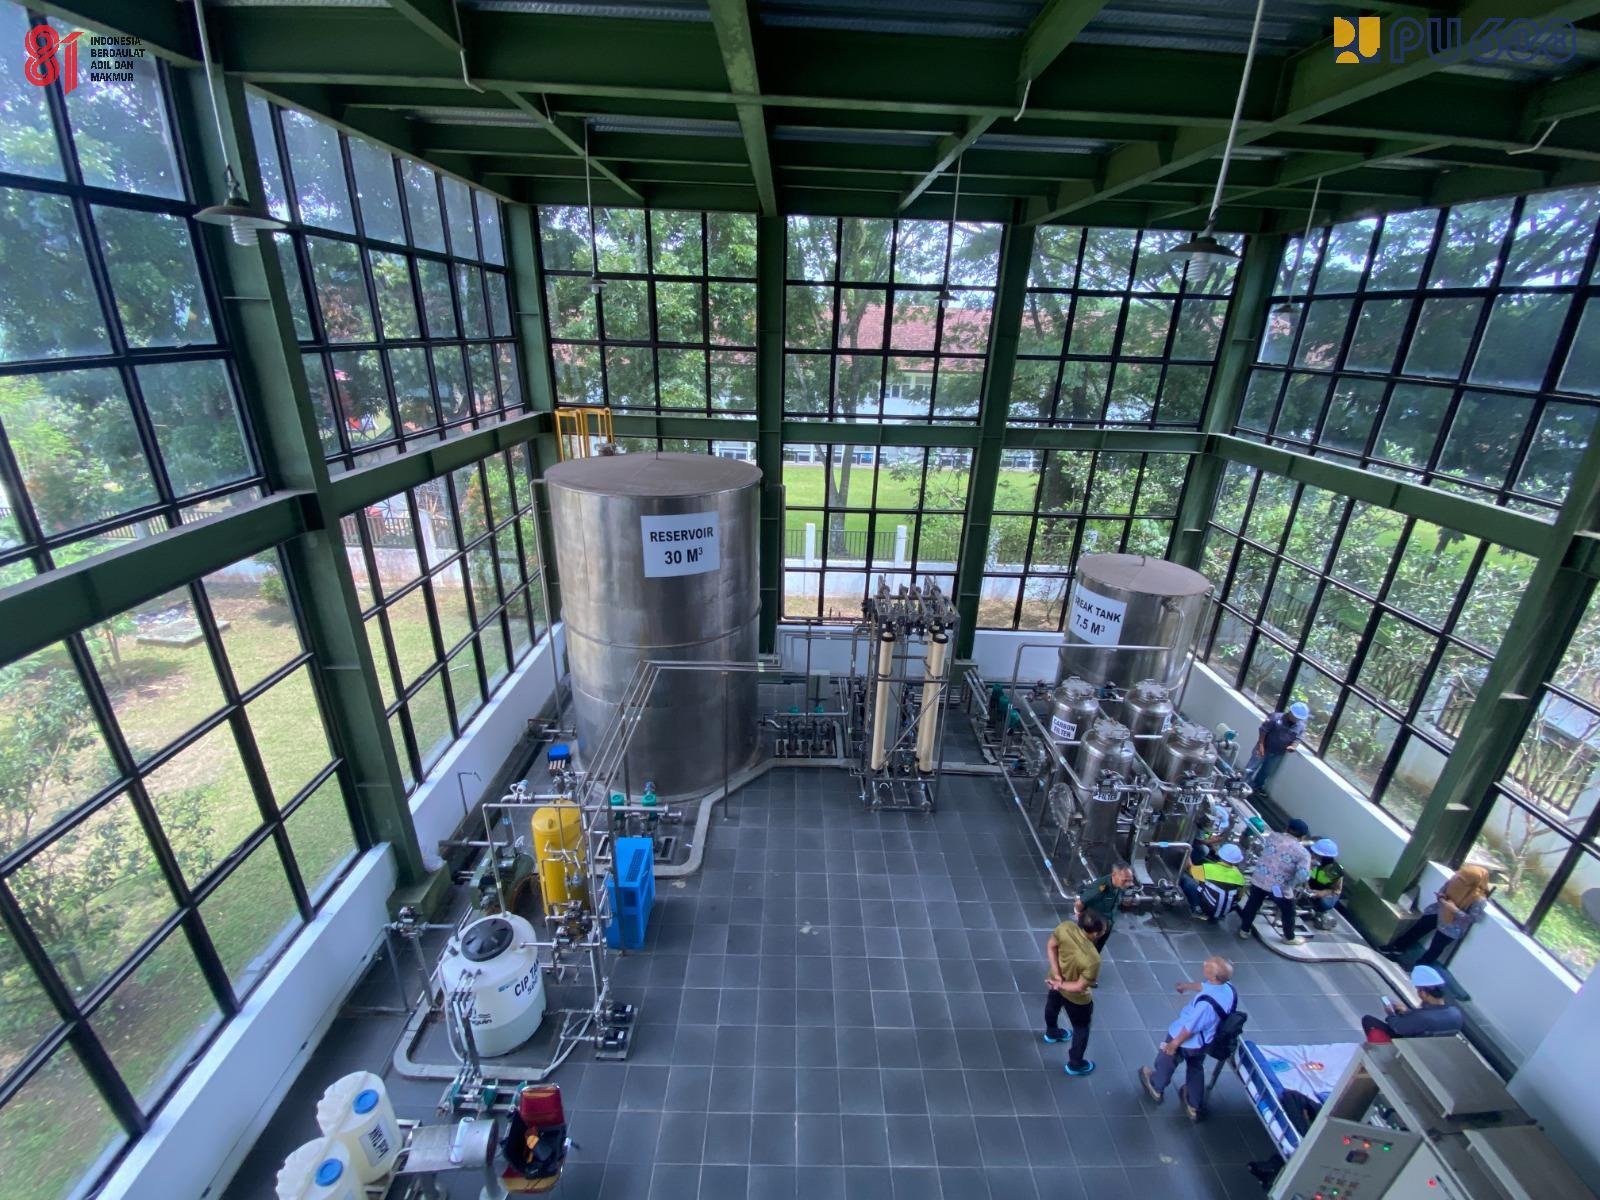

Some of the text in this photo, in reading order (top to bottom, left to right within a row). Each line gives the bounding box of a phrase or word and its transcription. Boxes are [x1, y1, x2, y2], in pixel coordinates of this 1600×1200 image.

[650, 527, 713, 542] RESERVOIR
[664, 550, 682, 564] 30
[1075, 595, 1121, 623] REAK TANK
[1076, 614, 1089, 630] 7.5
[1054, 719, 1075, 732] CARBON
[514, 976, 528, 996] CIP
